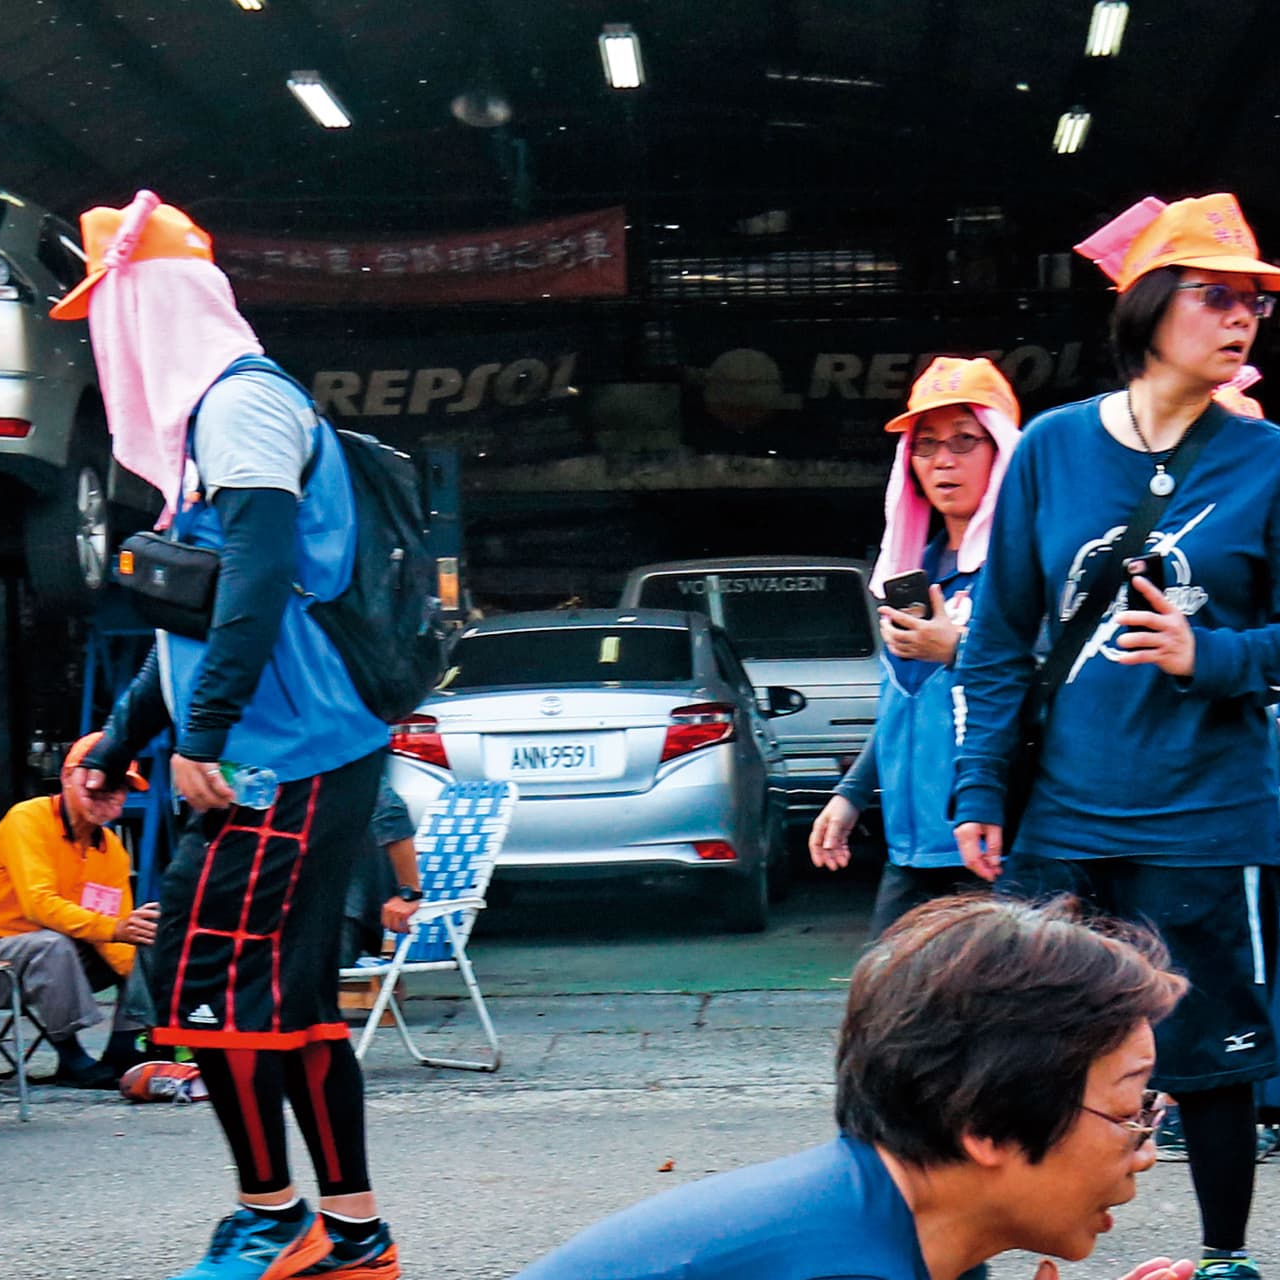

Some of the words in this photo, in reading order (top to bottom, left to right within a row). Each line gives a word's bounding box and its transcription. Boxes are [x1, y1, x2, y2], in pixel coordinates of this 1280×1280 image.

[312, 353, 579, 416] REPSOL
[808, 342, 1083, 400] REOL
[510, 745, 596, 770] ANN-9591
